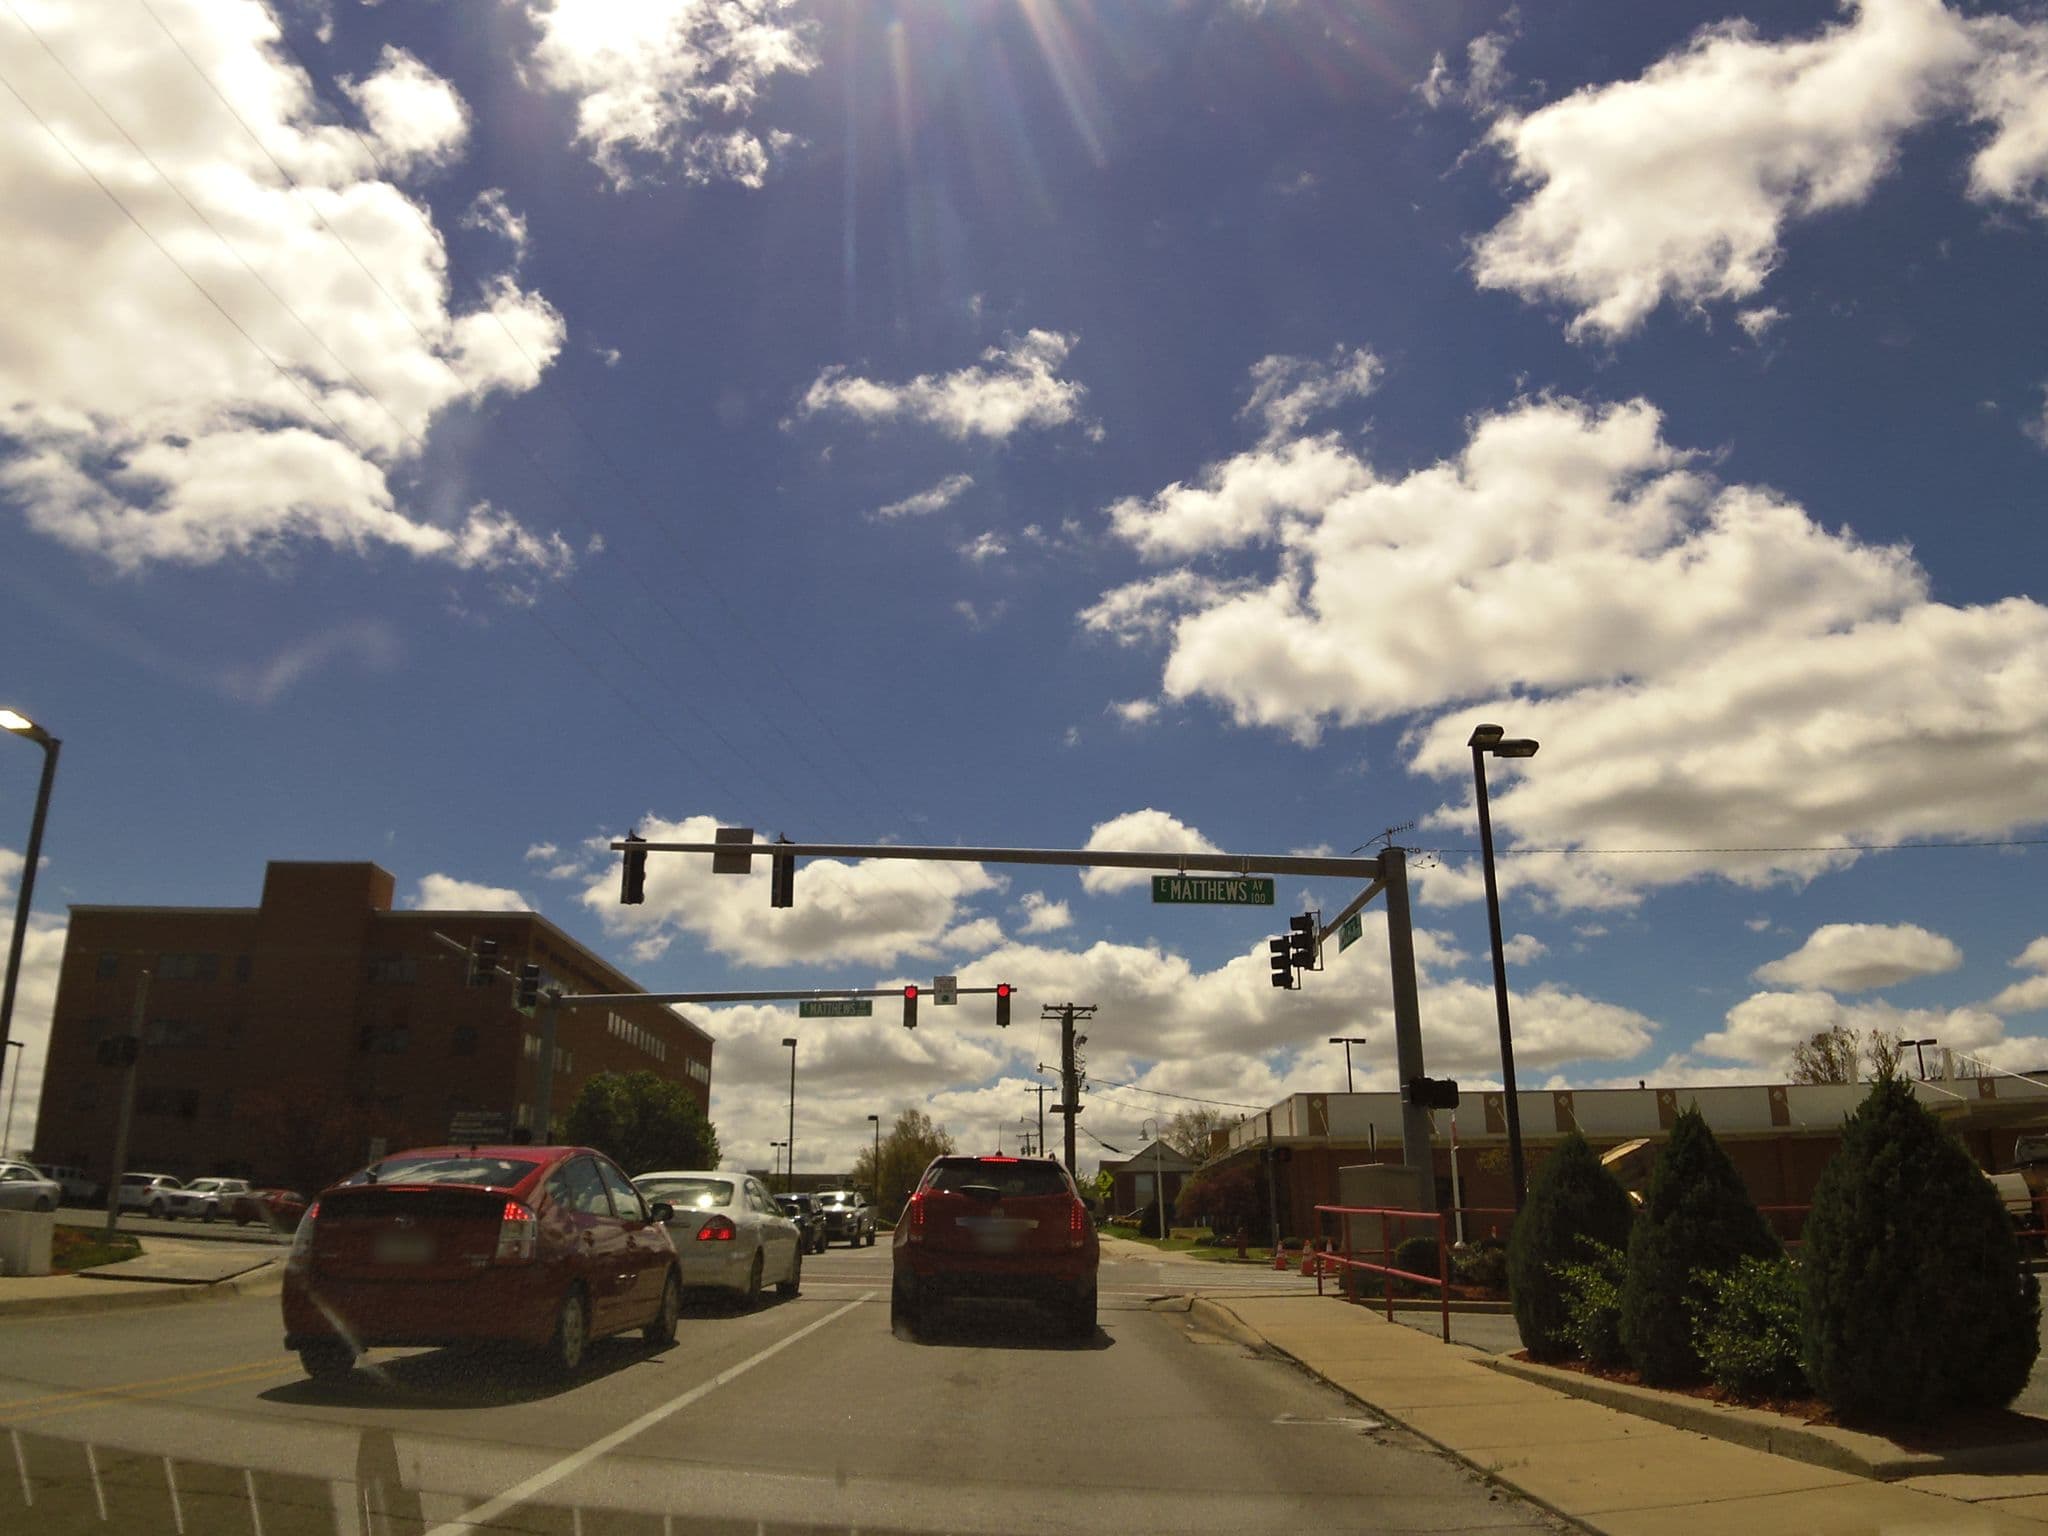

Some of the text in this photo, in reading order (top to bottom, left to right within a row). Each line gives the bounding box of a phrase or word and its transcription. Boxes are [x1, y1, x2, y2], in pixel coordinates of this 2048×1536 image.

[1160, 879, 1264, 901] E MATTHEWS AV
[1251, 893, 1266, 904] 100
